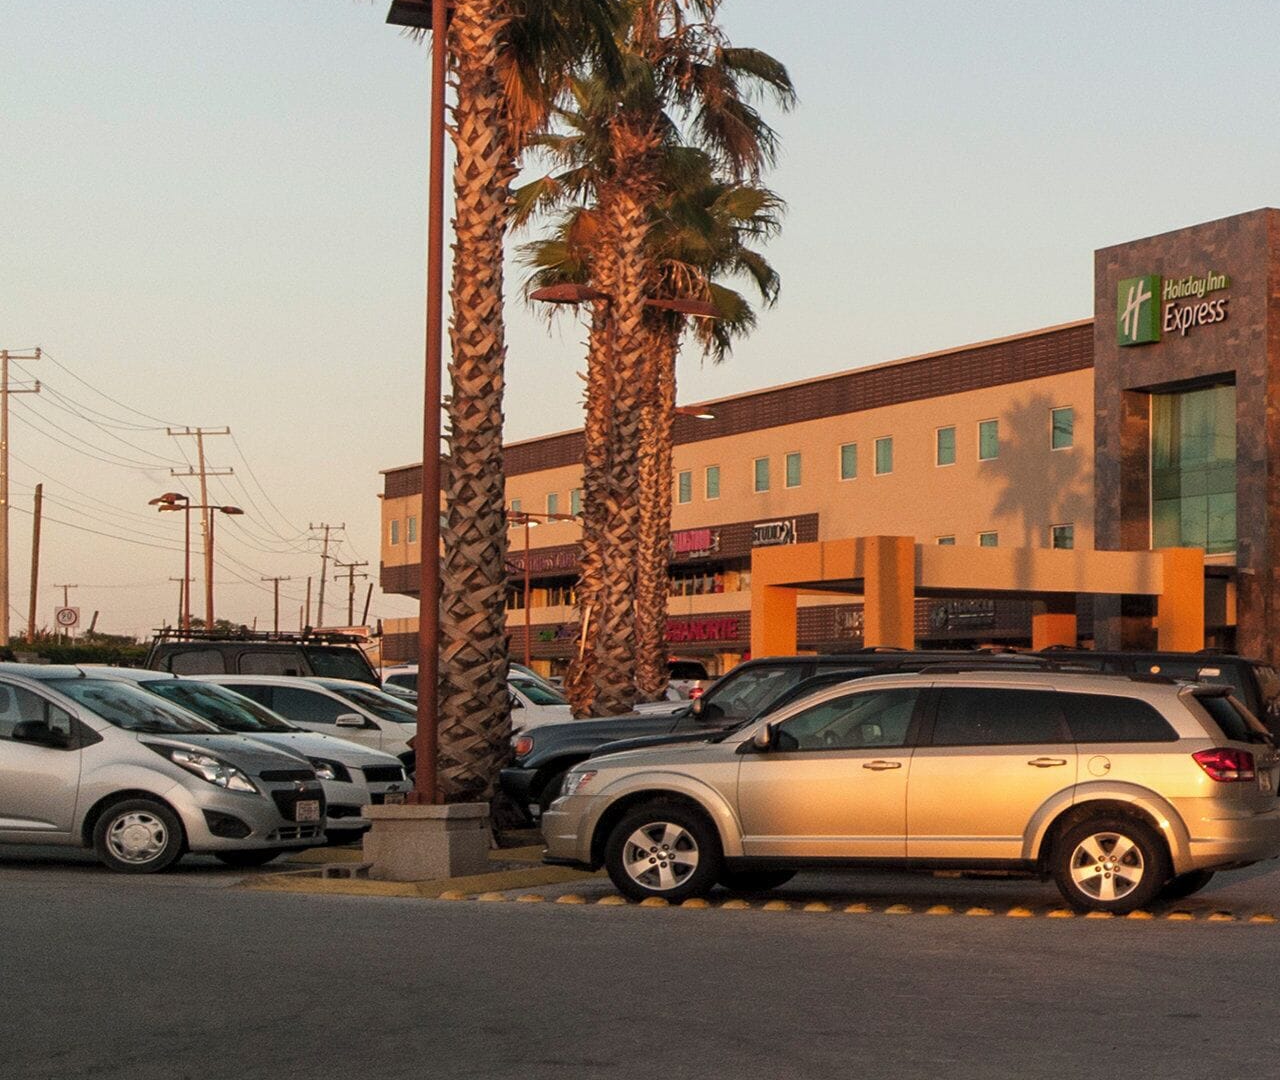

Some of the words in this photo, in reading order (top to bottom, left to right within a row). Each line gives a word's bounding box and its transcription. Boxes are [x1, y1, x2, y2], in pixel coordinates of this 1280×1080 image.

[1163, 275, 1206, 300] Holiday
[1206, 270, 1227, 291] Inn
[1121, 280, 1152, 340] H
[1163, 299, 1226, 336] Express
[752, 524, 784, 543] STUDIO
